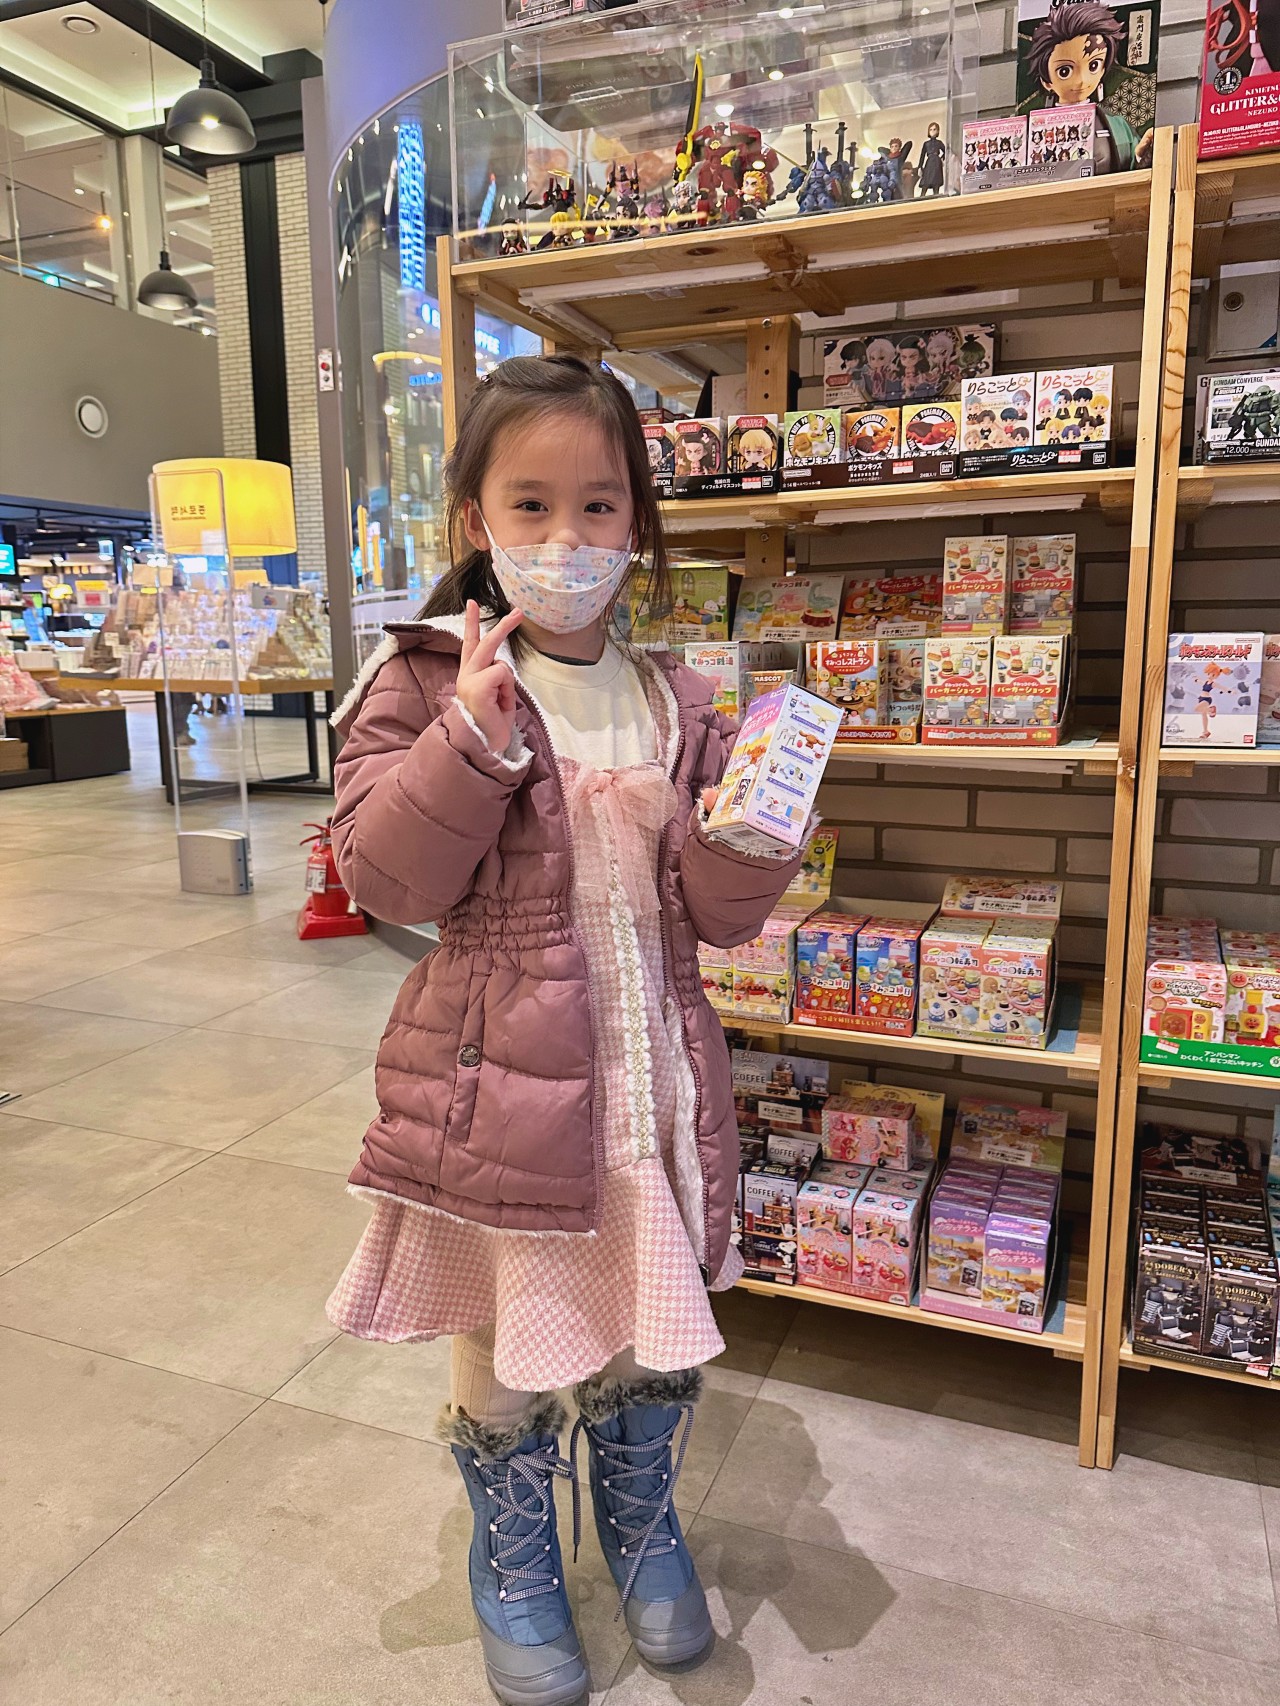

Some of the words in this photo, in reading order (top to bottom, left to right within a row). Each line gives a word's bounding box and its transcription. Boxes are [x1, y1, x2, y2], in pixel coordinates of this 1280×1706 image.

[1210, 93, 1280, 116] GLITTER&
[966, 377, 1018, 397] りらこっと
[1038, 370, 1095, 392] りらこっと
[1010, 452, 1050, 467] りらこっと
[847, 462, 883, 472] ポケモンキッズ
[948, 582, 999, 591] バーガーショップ
[1017, 579, 1068, 588] バーガーショップ
[929, 686, 983, 694] バーガーショップ
[996, 686, 1053, 694] バーガーショップ
[1204, 1050, 1241, 1060] アンパンマン
[733, 1072, 767, 1084] COFFEE
[769, 1146, 797, 1158] COFFEE
[747, 1186, 777, 1198] COFFEE
[1154, 1261, 1195, 1275] DOBER'S
[1225, 1286, 1265, 1300] DOBER'S
